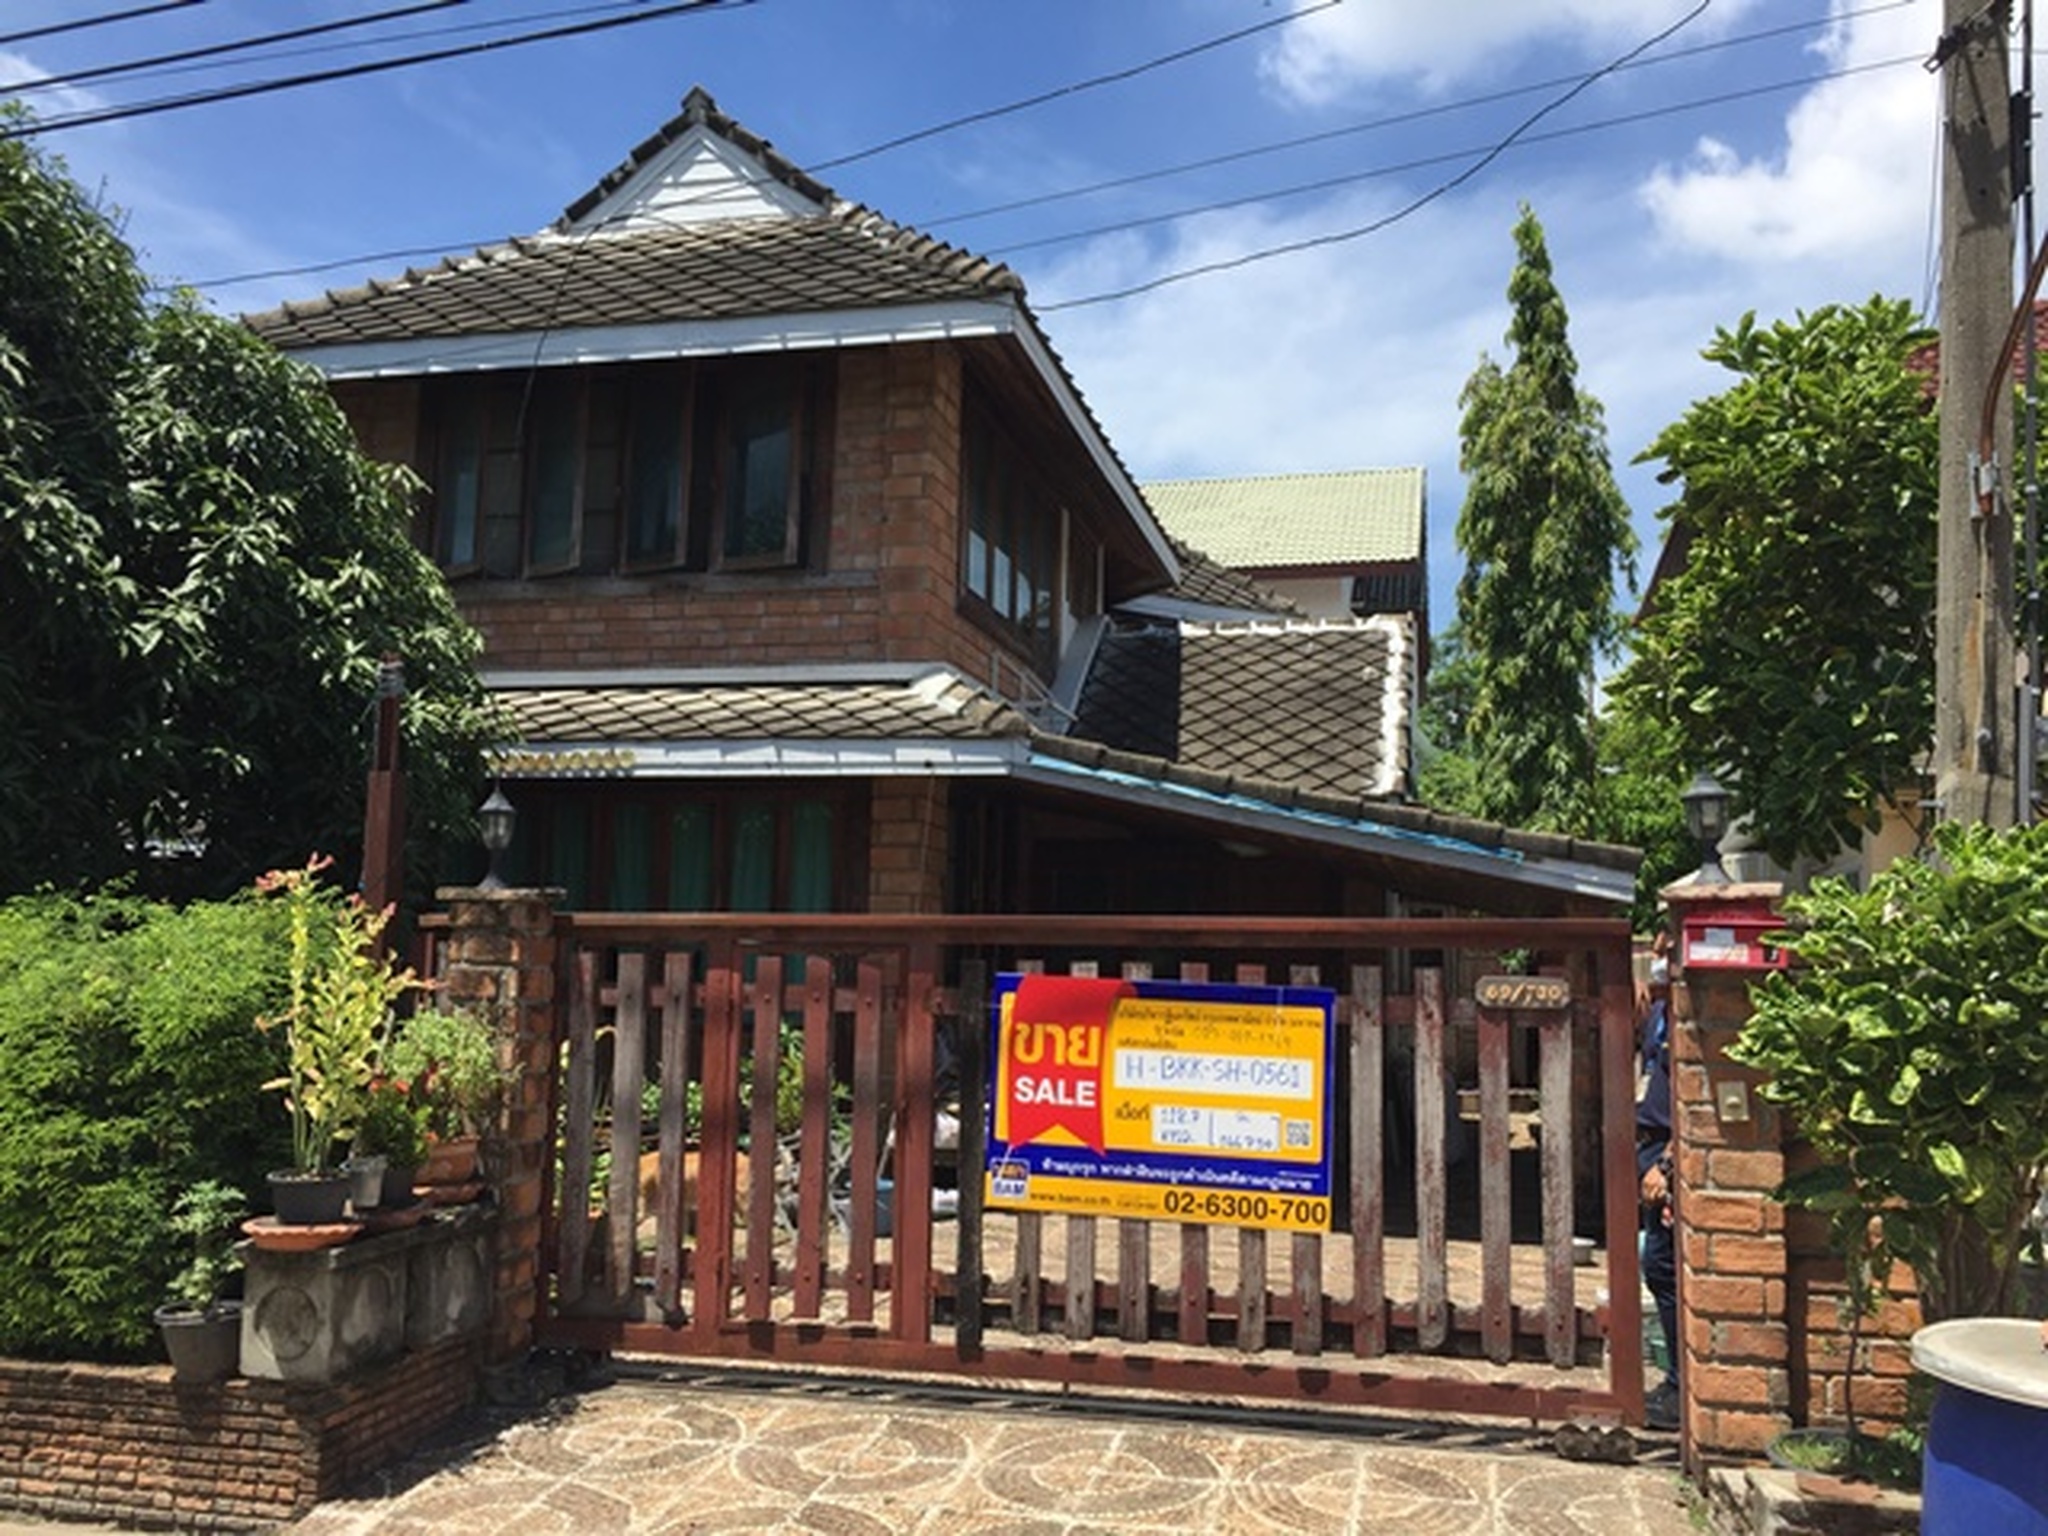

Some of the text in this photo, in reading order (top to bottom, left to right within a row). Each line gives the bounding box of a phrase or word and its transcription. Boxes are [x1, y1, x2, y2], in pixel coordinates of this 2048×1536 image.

[1014, 1021, 1101, 1067] ขาย
[1014, 1076, 1096, 1108] SALE
[1164, 1189, 1328, 1226] 02-6300-700
